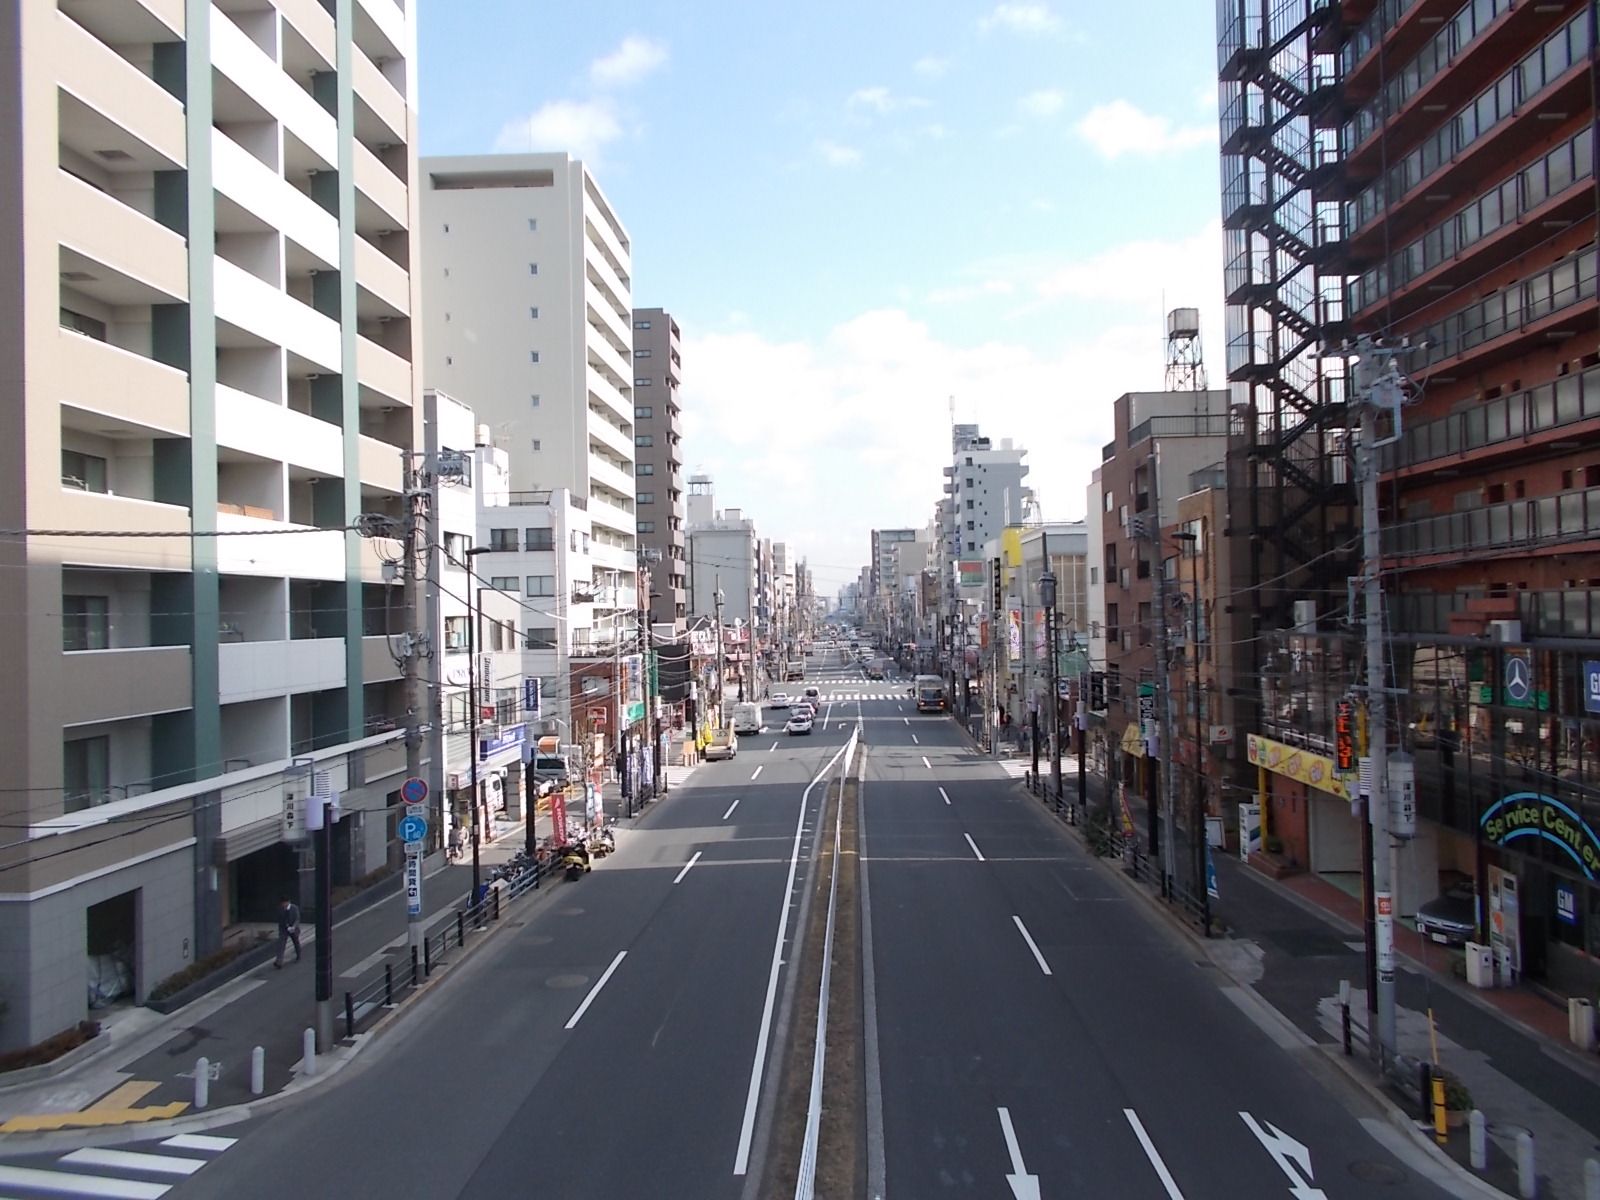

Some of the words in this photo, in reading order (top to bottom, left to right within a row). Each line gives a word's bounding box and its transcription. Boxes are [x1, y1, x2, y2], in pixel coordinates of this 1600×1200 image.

[1590, 672, 1600, 694] G
[405, 823, 416, 840] P
[1485, 804, 1540, 841] Service
[1557, 889, 1574, 913] GM
